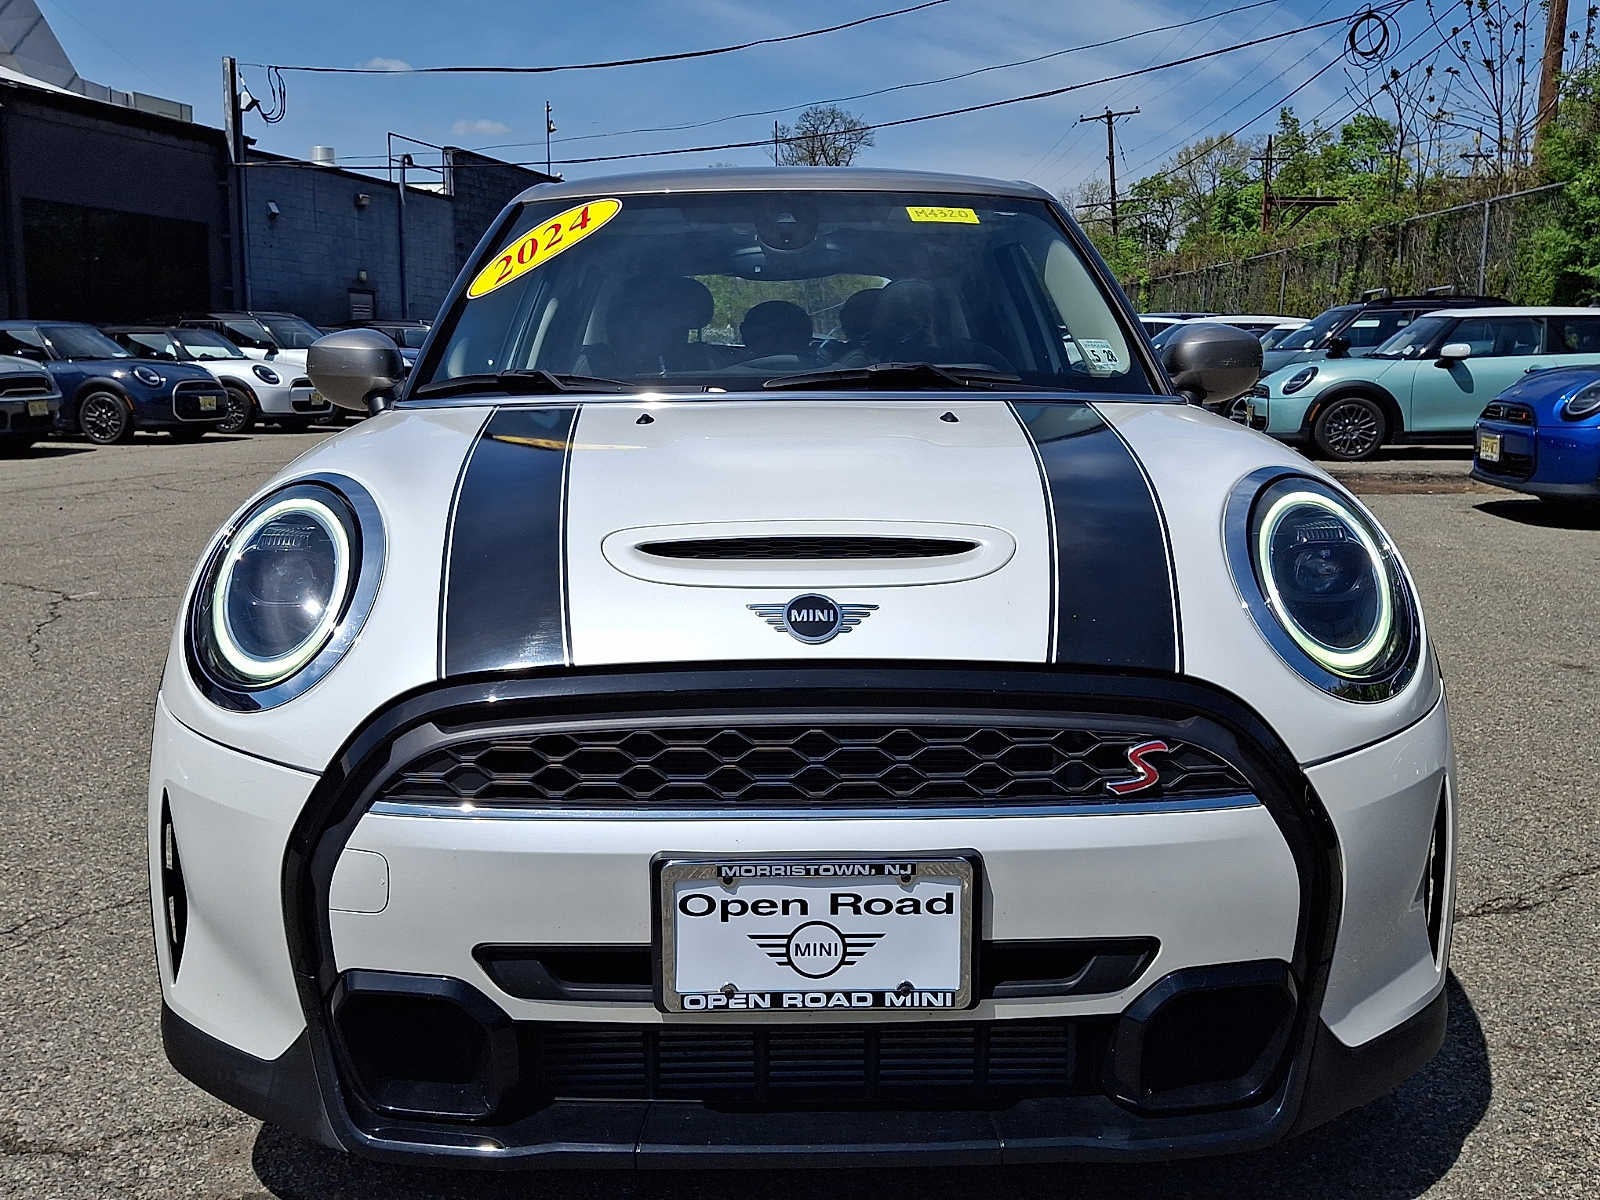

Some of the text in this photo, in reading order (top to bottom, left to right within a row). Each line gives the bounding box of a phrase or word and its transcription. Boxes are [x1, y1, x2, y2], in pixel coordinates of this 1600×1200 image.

[494, 205, 592, 285] 2024
[790, 608, 835, 622] MINI
[1106, 740, 1169, 795] S
[721, 863, 914, 877] MORRISTOWN, NJ
[678, 891, 954, 922] Open Road
[794, 942, 839, 957] MINI
[683, 991, 953, 1010] OPEN ROAD MINI
